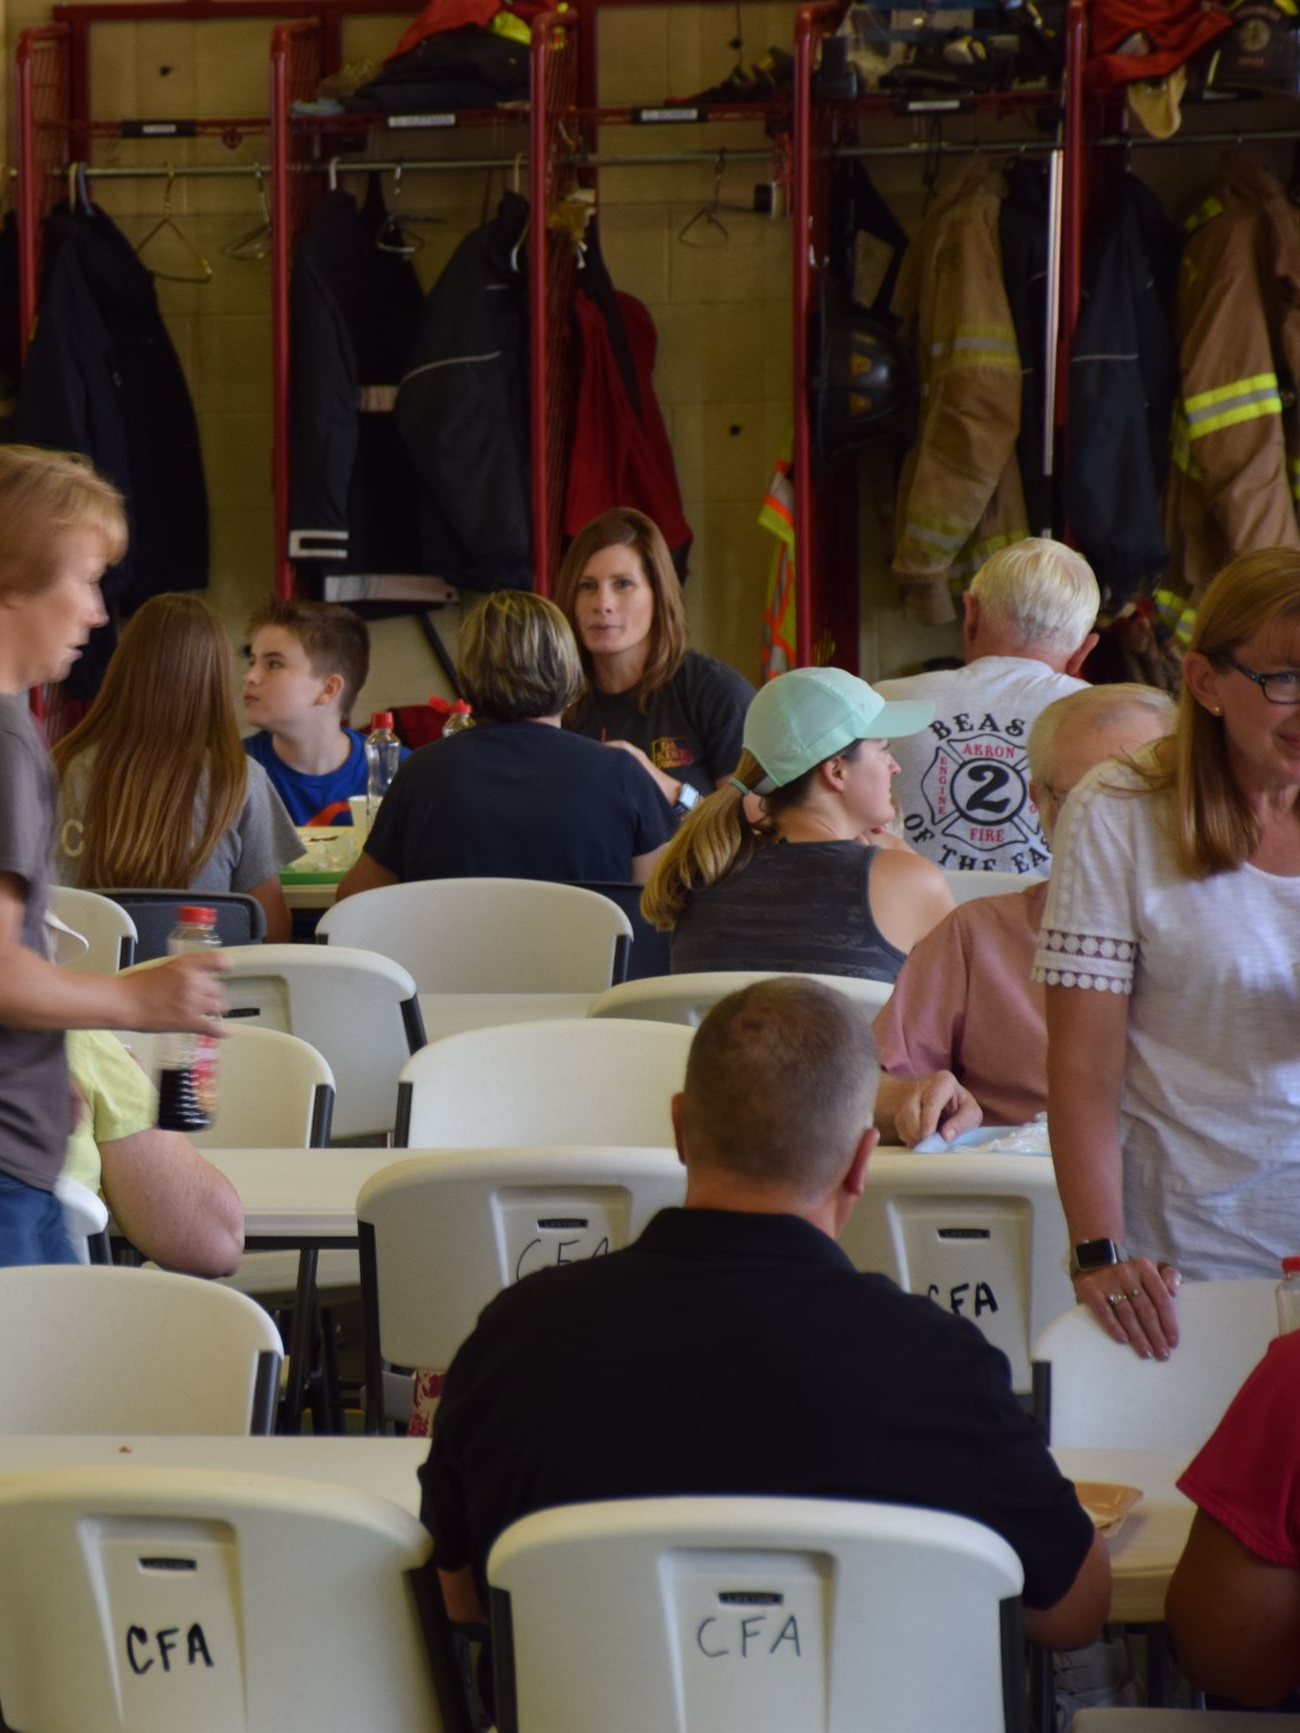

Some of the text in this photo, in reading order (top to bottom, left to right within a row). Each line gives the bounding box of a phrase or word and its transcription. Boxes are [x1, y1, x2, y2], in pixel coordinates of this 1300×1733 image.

[962, 743, 1016, 758] AKRON
[937, 756, 947, 815] ENGINE
[965, 764, 1011, 814] 2
[904, 813, 935, 844] OF
[938, 844, 996, 871] THE
[969, 828, 1005, 843] FIRE
[126, 1623, 214, 1675] CFA
[697, 1614, 801, 1658] CFA
